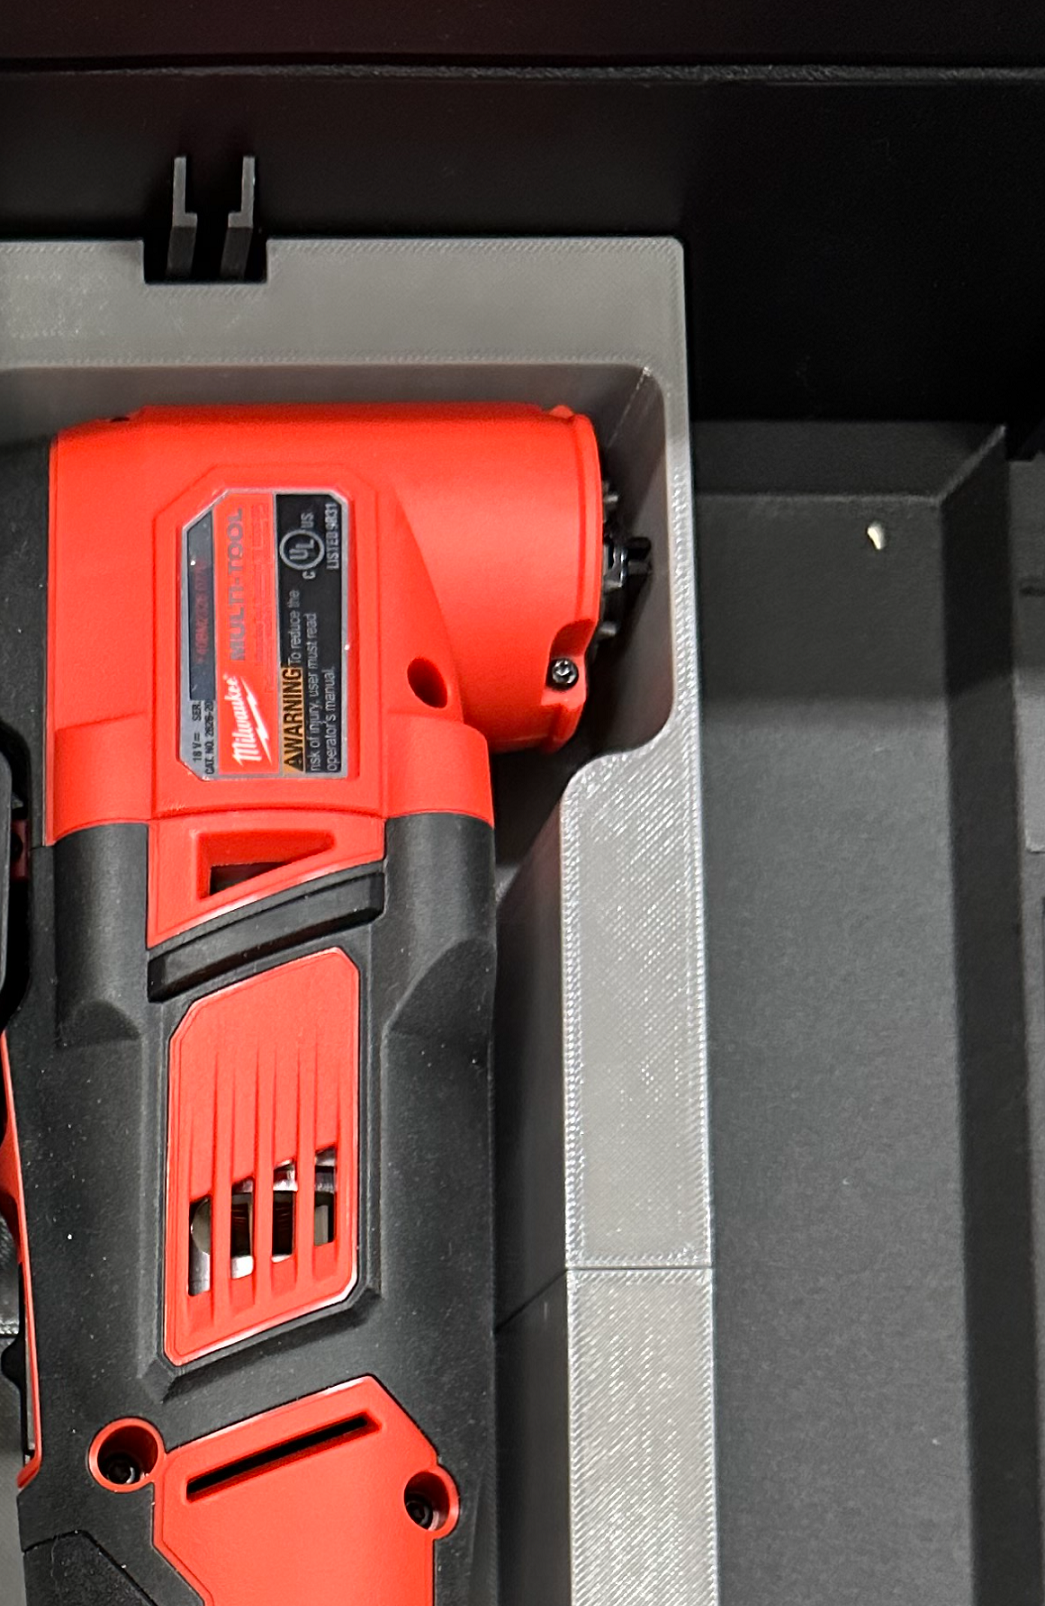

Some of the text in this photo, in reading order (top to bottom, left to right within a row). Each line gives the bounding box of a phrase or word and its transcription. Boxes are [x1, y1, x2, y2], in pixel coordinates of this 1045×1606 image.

[289, 539, 314, 560] UL
[326, 532, 339, 569] LISTED
[227, 508, 246, 661] MULTI-TOOL
[288, 590, 301, 664] To reduce the
[304, 613, 317, 638] read
[307, 642, 318, 669] must
[308, 673, 318, 697] user
[224, 676, 262, 766] Milwaukee
[282, 668, 303, 754] WARNING
[307, 736, 320, 748] of
[325, 714, 339, 771] operator's
[206, 757, 214, 774] CAT.
[308, 751, 321, 771] risk
